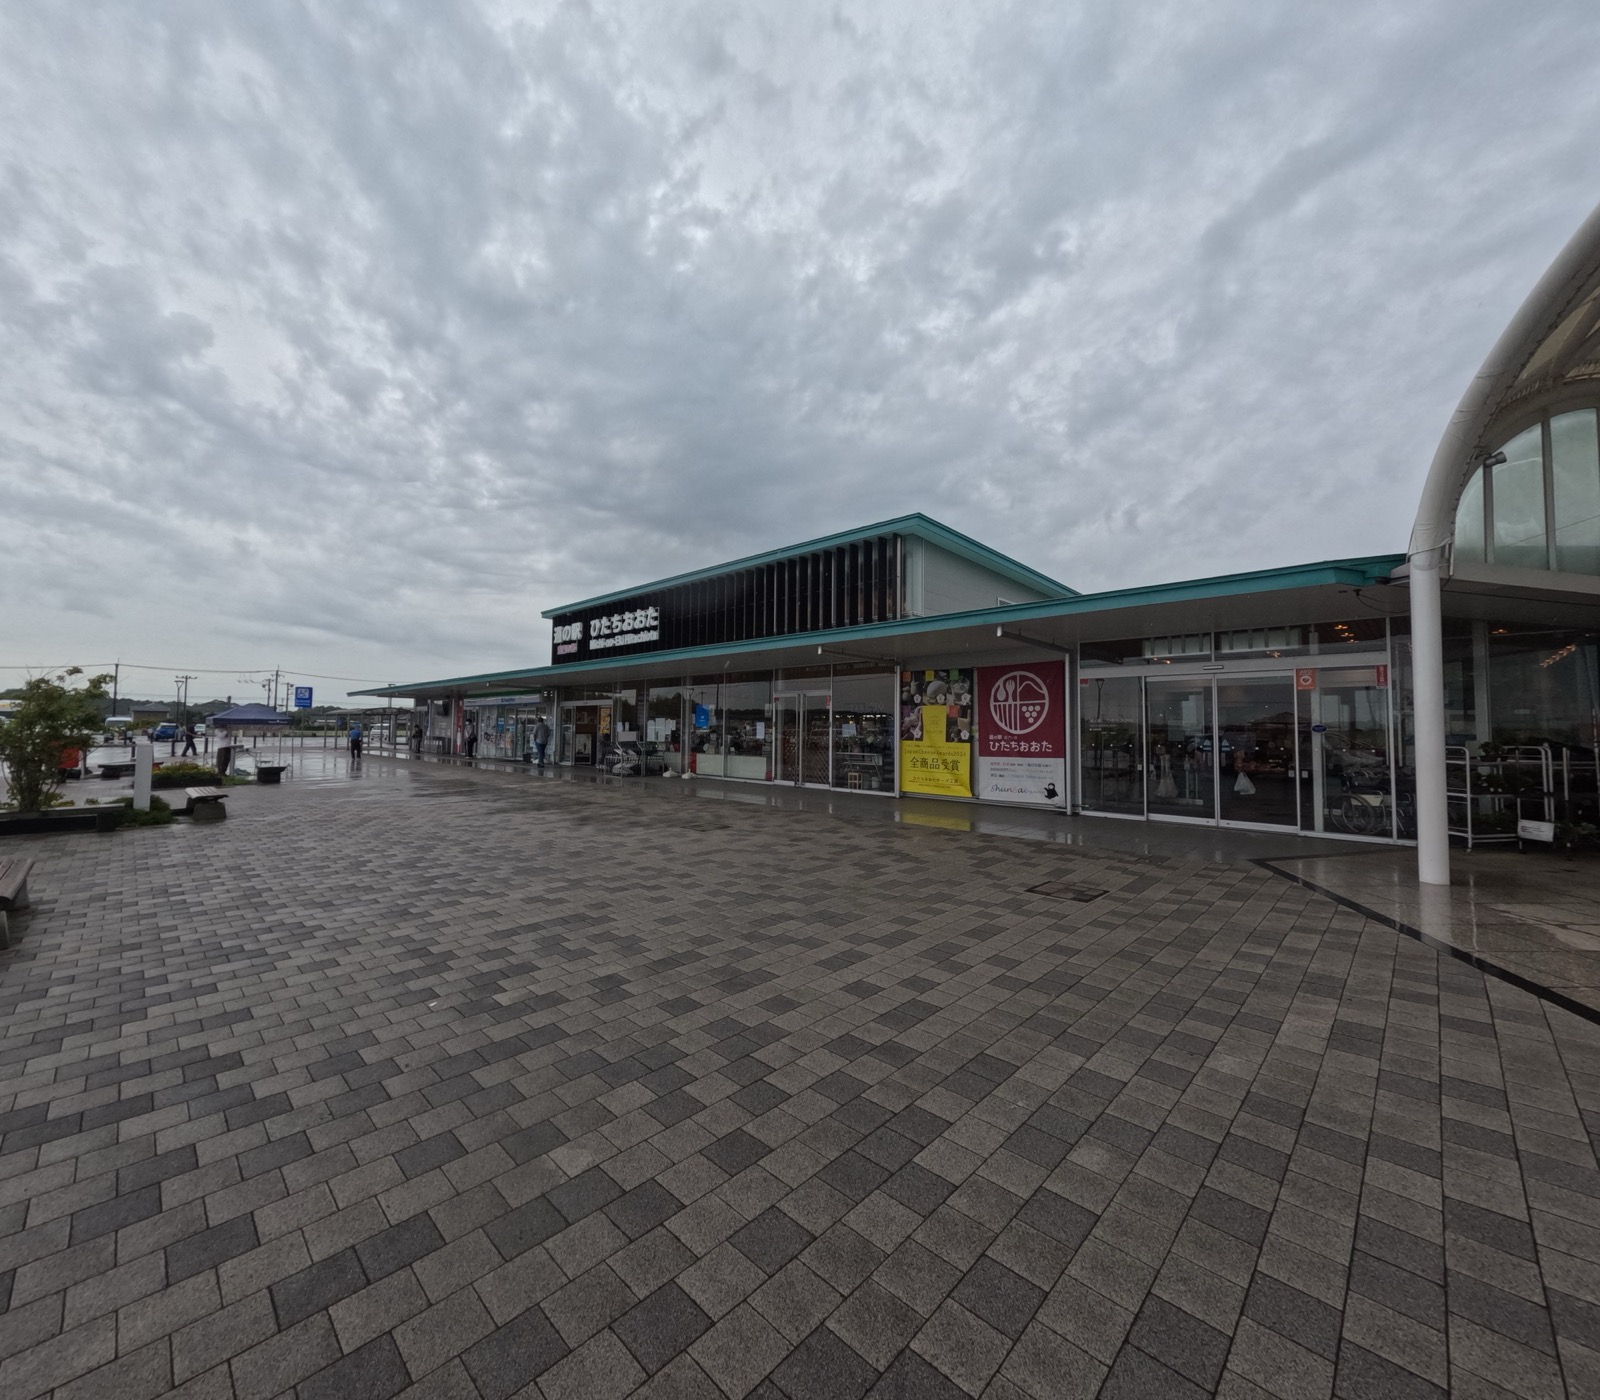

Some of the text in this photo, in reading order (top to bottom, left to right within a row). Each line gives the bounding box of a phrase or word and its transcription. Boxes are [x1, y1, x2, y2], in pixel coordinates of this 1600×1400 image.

[590, 607, 659, 636] ひたちおおた
[988, 740, 1053, 752] ひたちおおた
[909, 756, 961, 772] 全商品受賞
